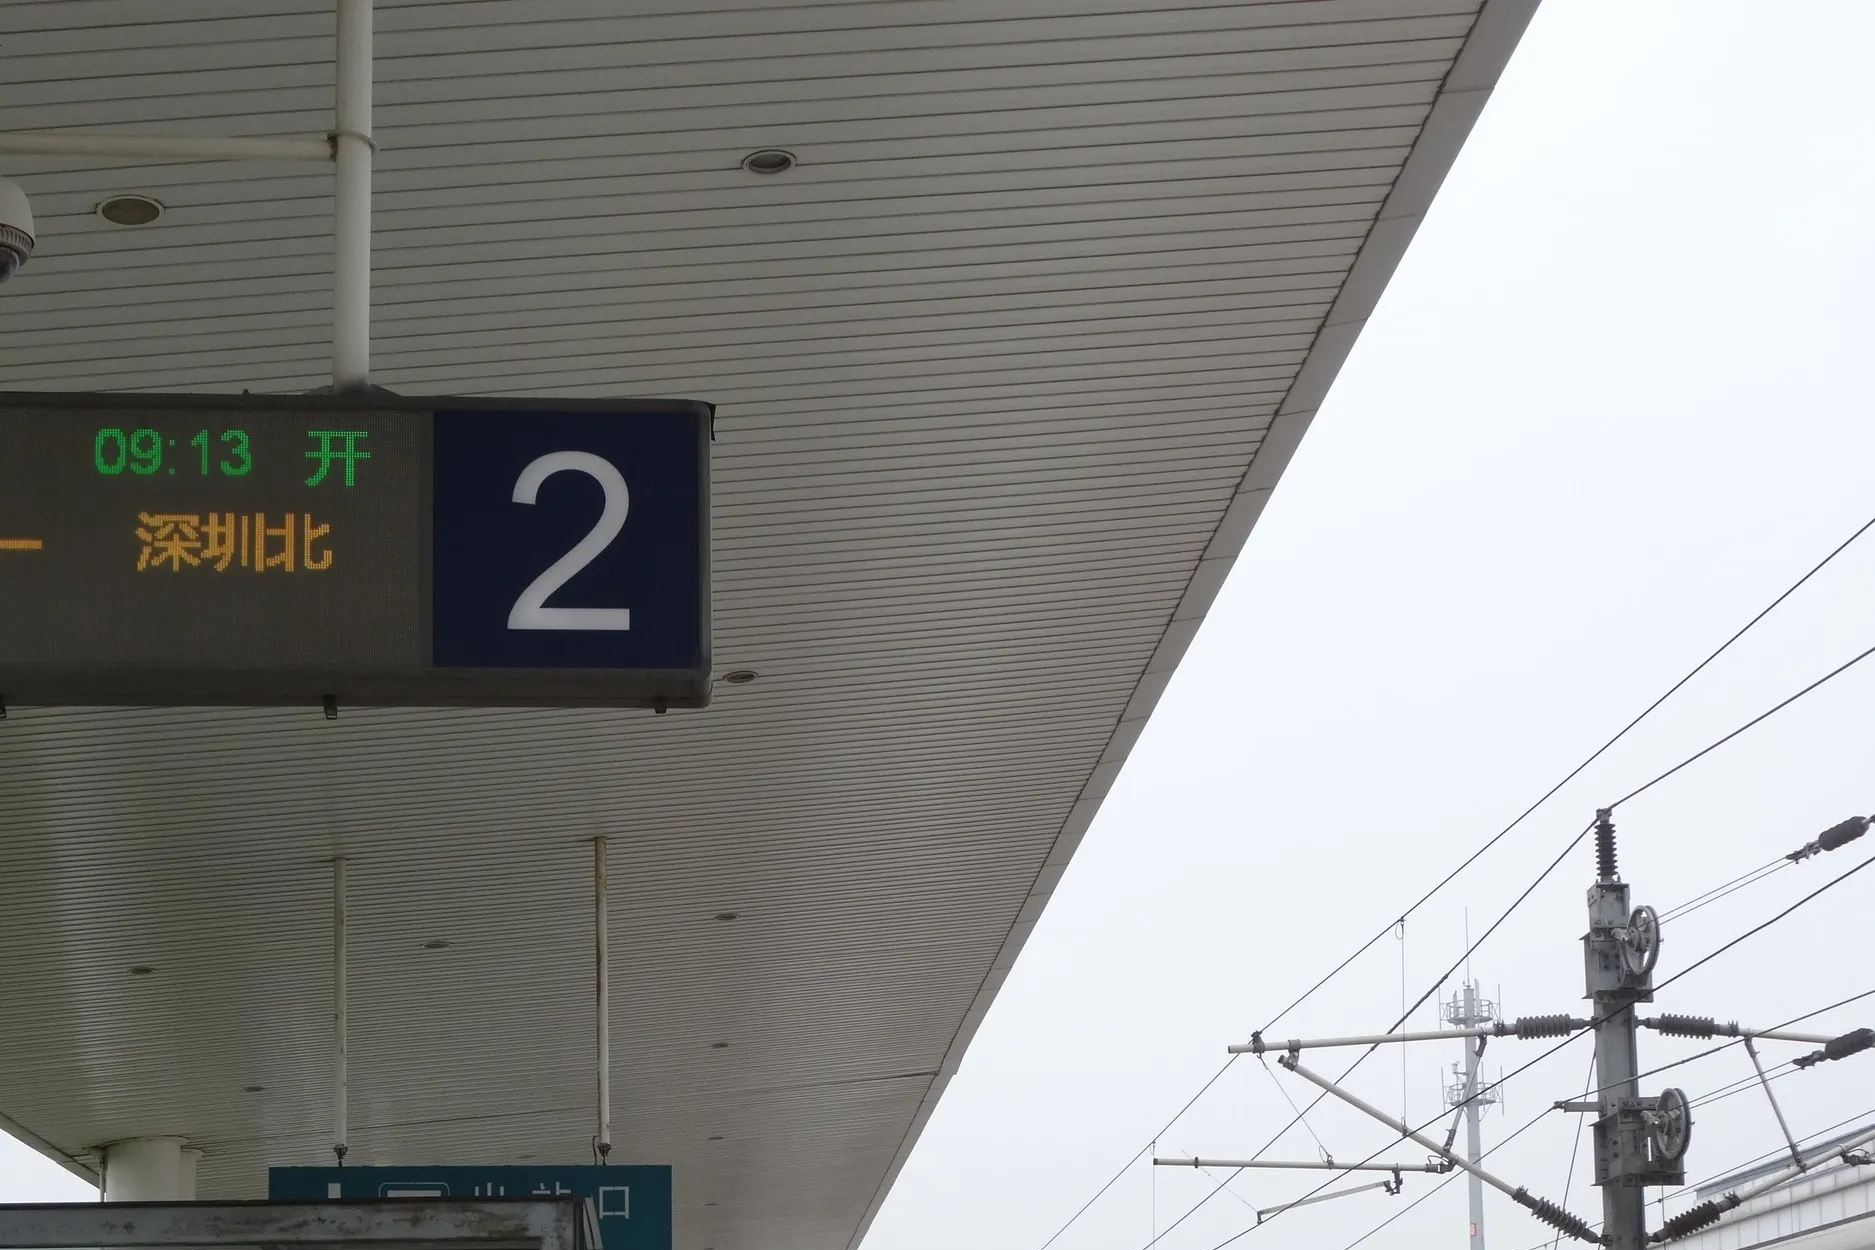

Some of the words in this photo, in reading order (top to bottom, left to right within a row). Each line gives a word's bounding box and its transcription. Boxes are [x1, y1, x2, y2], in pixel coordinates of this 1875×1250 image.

[94, 428, 253, 477] 09:13
[304, 430, 371, 487] 开
[135, 511, 333, 573] 深圳北
[507, 450, 630, 631] 2
